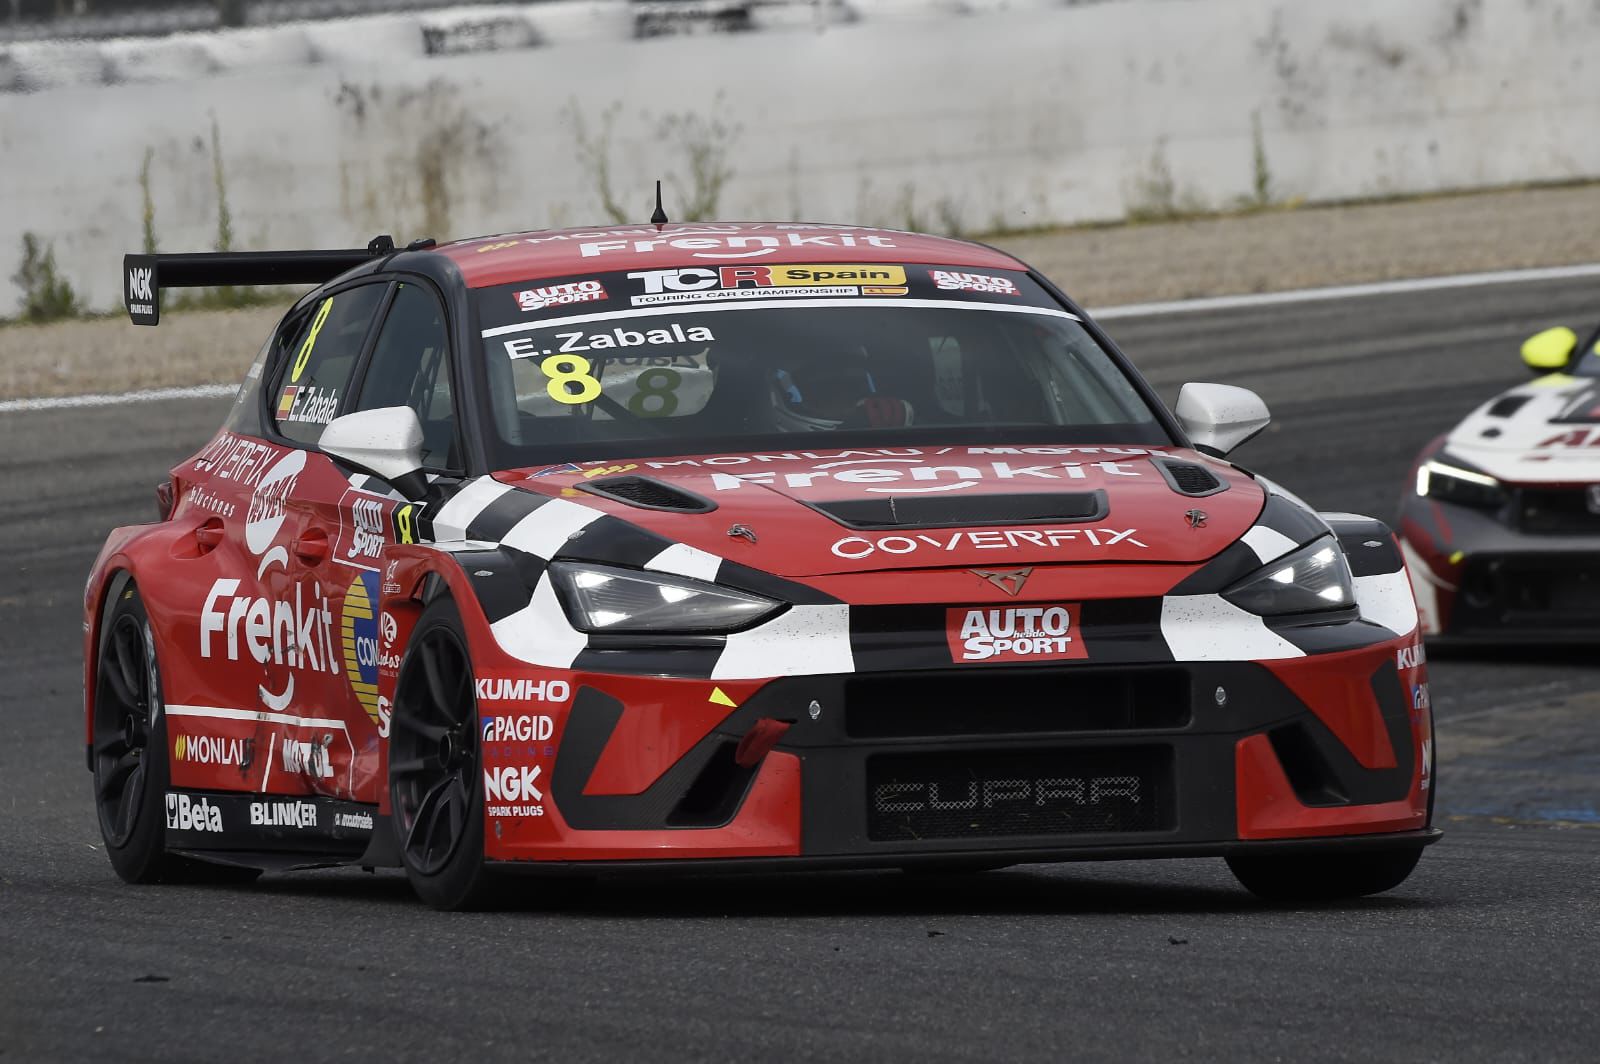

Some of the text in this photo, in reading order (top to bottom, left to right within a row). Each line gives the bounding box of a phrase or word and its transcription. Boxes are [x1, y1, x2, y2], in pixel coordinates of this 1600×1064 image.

[580, 233, 896, 257] Frenkit
[129, 267, 153, 301] NGK
[519, 281, 601, 303] AUTO
[627, 266, 889, 294] TCR Spain
[933, 270, 1013, 288] AUTO
[937, 279, 1016, 294] SPORT
[521, 291, 604, 311] SPORT
[638, 288, 853, 304] TOURING CAR CHAMPIONSHIP
[291, 297, 334, 383] 8
[541, 354, 602, 405] 8
[645, 448, 924, 469] MONLAU
[711, 461, 1142, 490] Frenkit
[353, 498, 383, 533] AUTO
[348, 526, 385, 558] SPORT
[831, 529, 1150, 559] COVERFIX
[201, 578, 339, 675] Frenkit
[960, 606, 1070, 640] AUTO
[1013, 628, 1045, 638] hebdo
[963, 637, 1072, 660] SPORT
[475, 678, 570, 702] KUMHO
[495, 715, 554, 741] PAGID
[484, 765, 543, 801] NGK
[875, 776, 1141, 812] CUPRA
[178, 794, 224, 832] Beta
[250, 801, 317, 828] BLINKER
[488, 805, 544, 817] SPARK PLUGS
